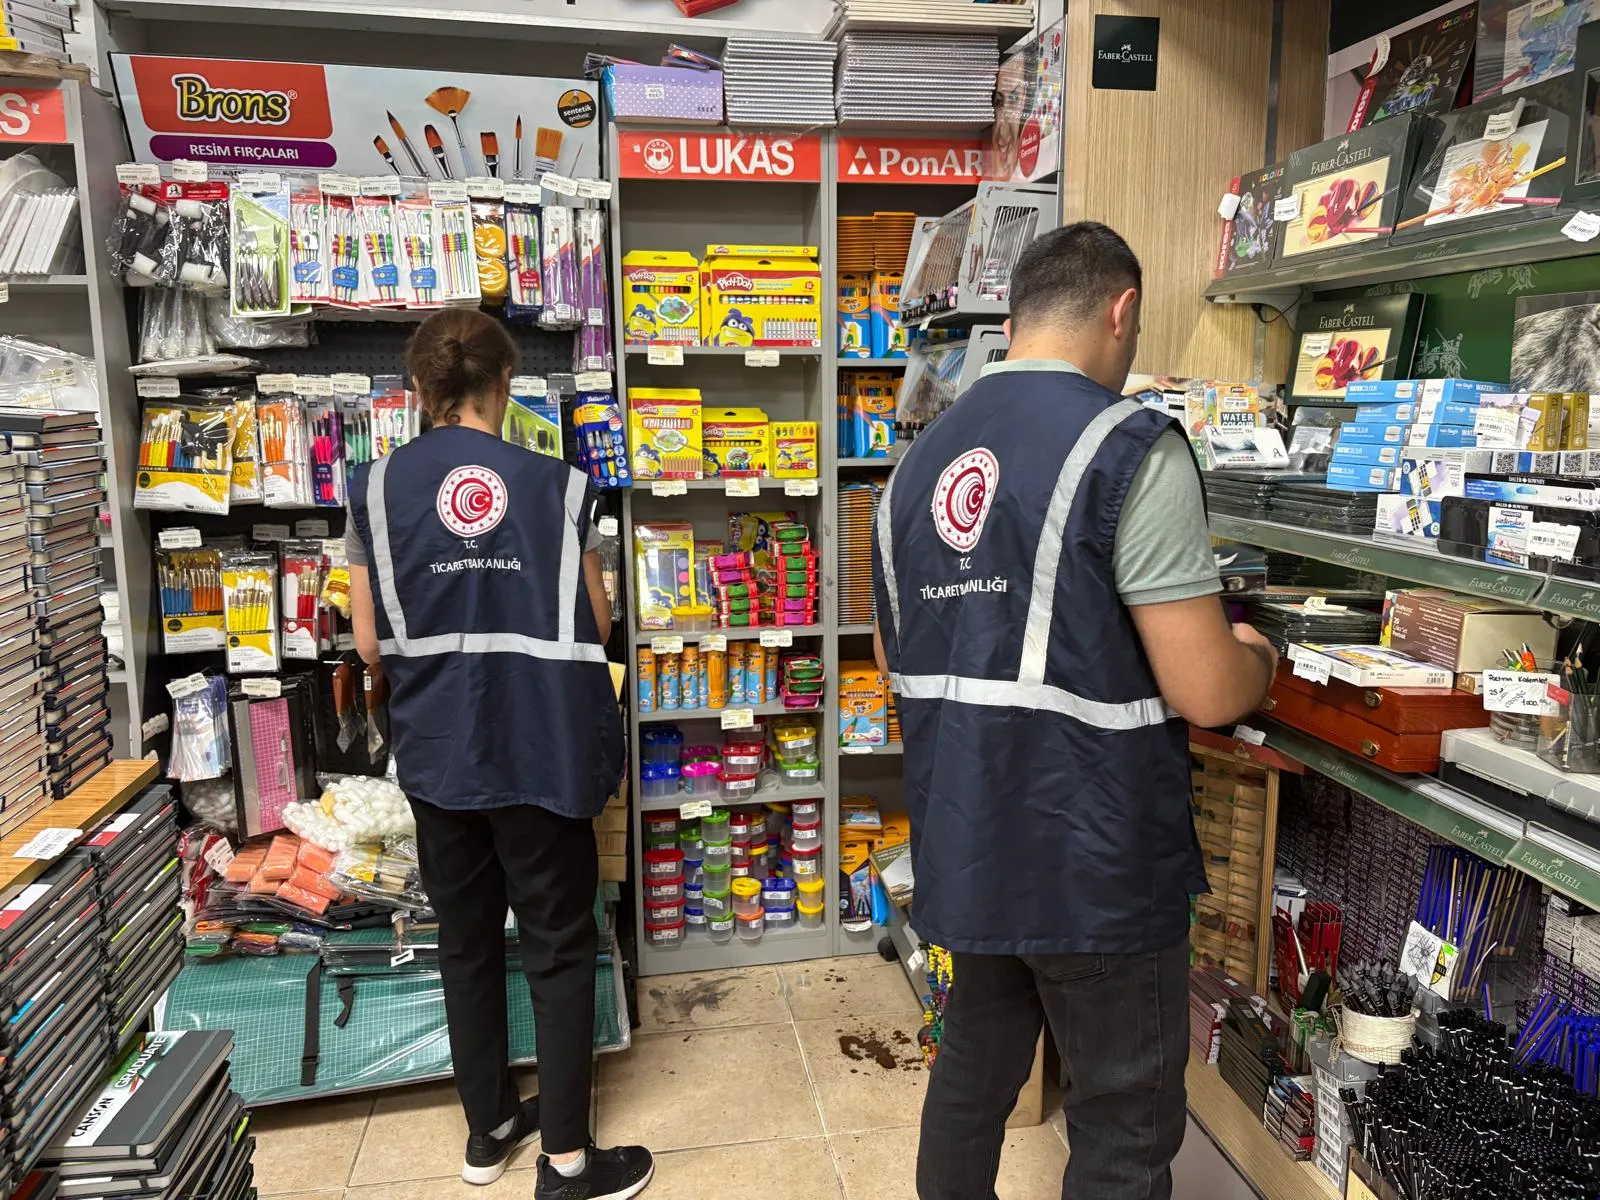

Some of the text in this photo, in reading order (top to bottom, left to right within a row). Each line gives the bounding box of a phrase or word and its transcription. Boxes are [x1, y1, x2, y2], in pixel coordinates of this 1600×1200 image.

[1098, 50, 1153, 62] FABER-CASTELL
[174, 76, 288, 123] Brons
[563, 106, 593, 117] sentetik
[189, 142, 299, 161] RESİM FIRÇALARI
[680, 137, 794, 176] LUKAS
[878, 147, 983, 178] PonAR
[1310, 147, 1374, 175] FABER-CASTELL
[1319, 313, 1376, 329] FABER-CASTELL
[1222, 413, 1254, 422] WATER
[1469, 577, 1528, 597] FABER-CASTELL
[1549, 591, 1600, 613] FABER-CAST
[1450, 825, 1505, 859] FABER-CASTELL
[1520, 852, 1582, 890] FABER-CASTELL
[115, 1035, 169, 1089] GRADUATE
[71, 1096, 115, 1139] CANSON
